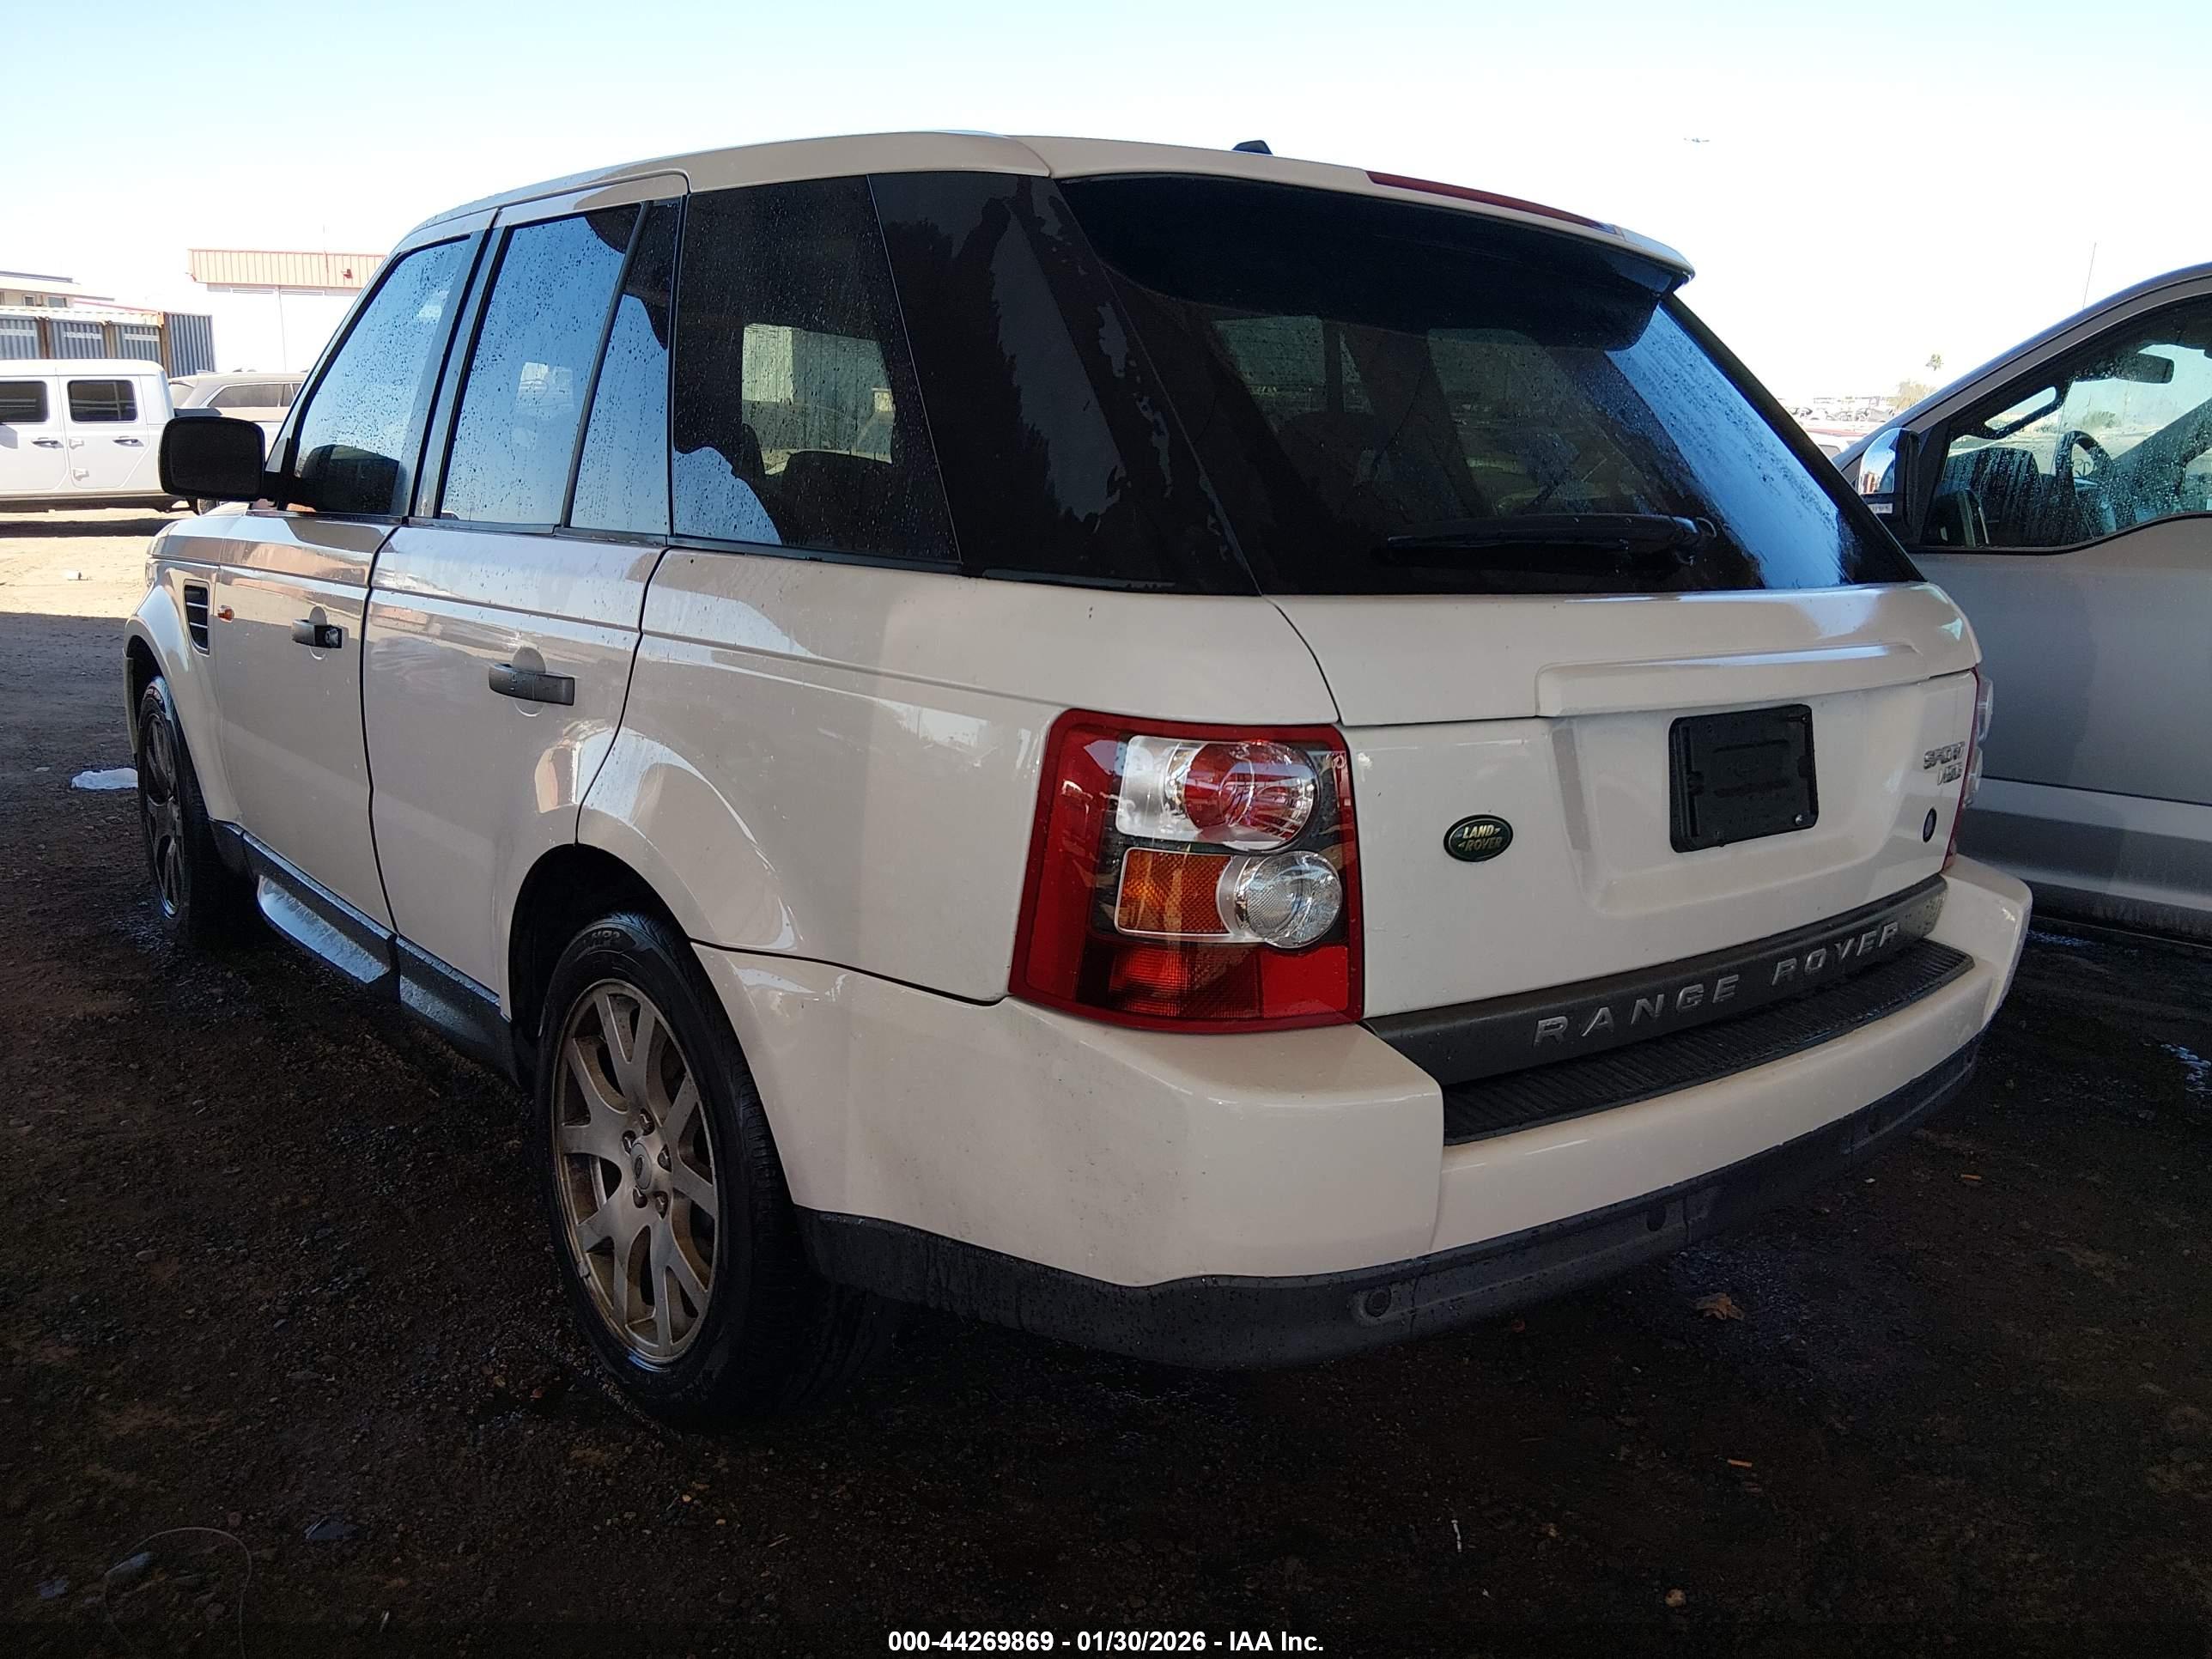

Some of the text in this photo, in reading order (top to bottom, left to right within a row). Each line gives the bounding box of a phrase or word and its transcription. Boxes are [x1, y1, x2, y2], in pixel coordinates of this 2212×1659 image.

[1463, 824, 1495, 838] LAND
[1466, 837, 1503, 851] ROVER
[1533, 922, 1899, 1047] RANGE ROVER
